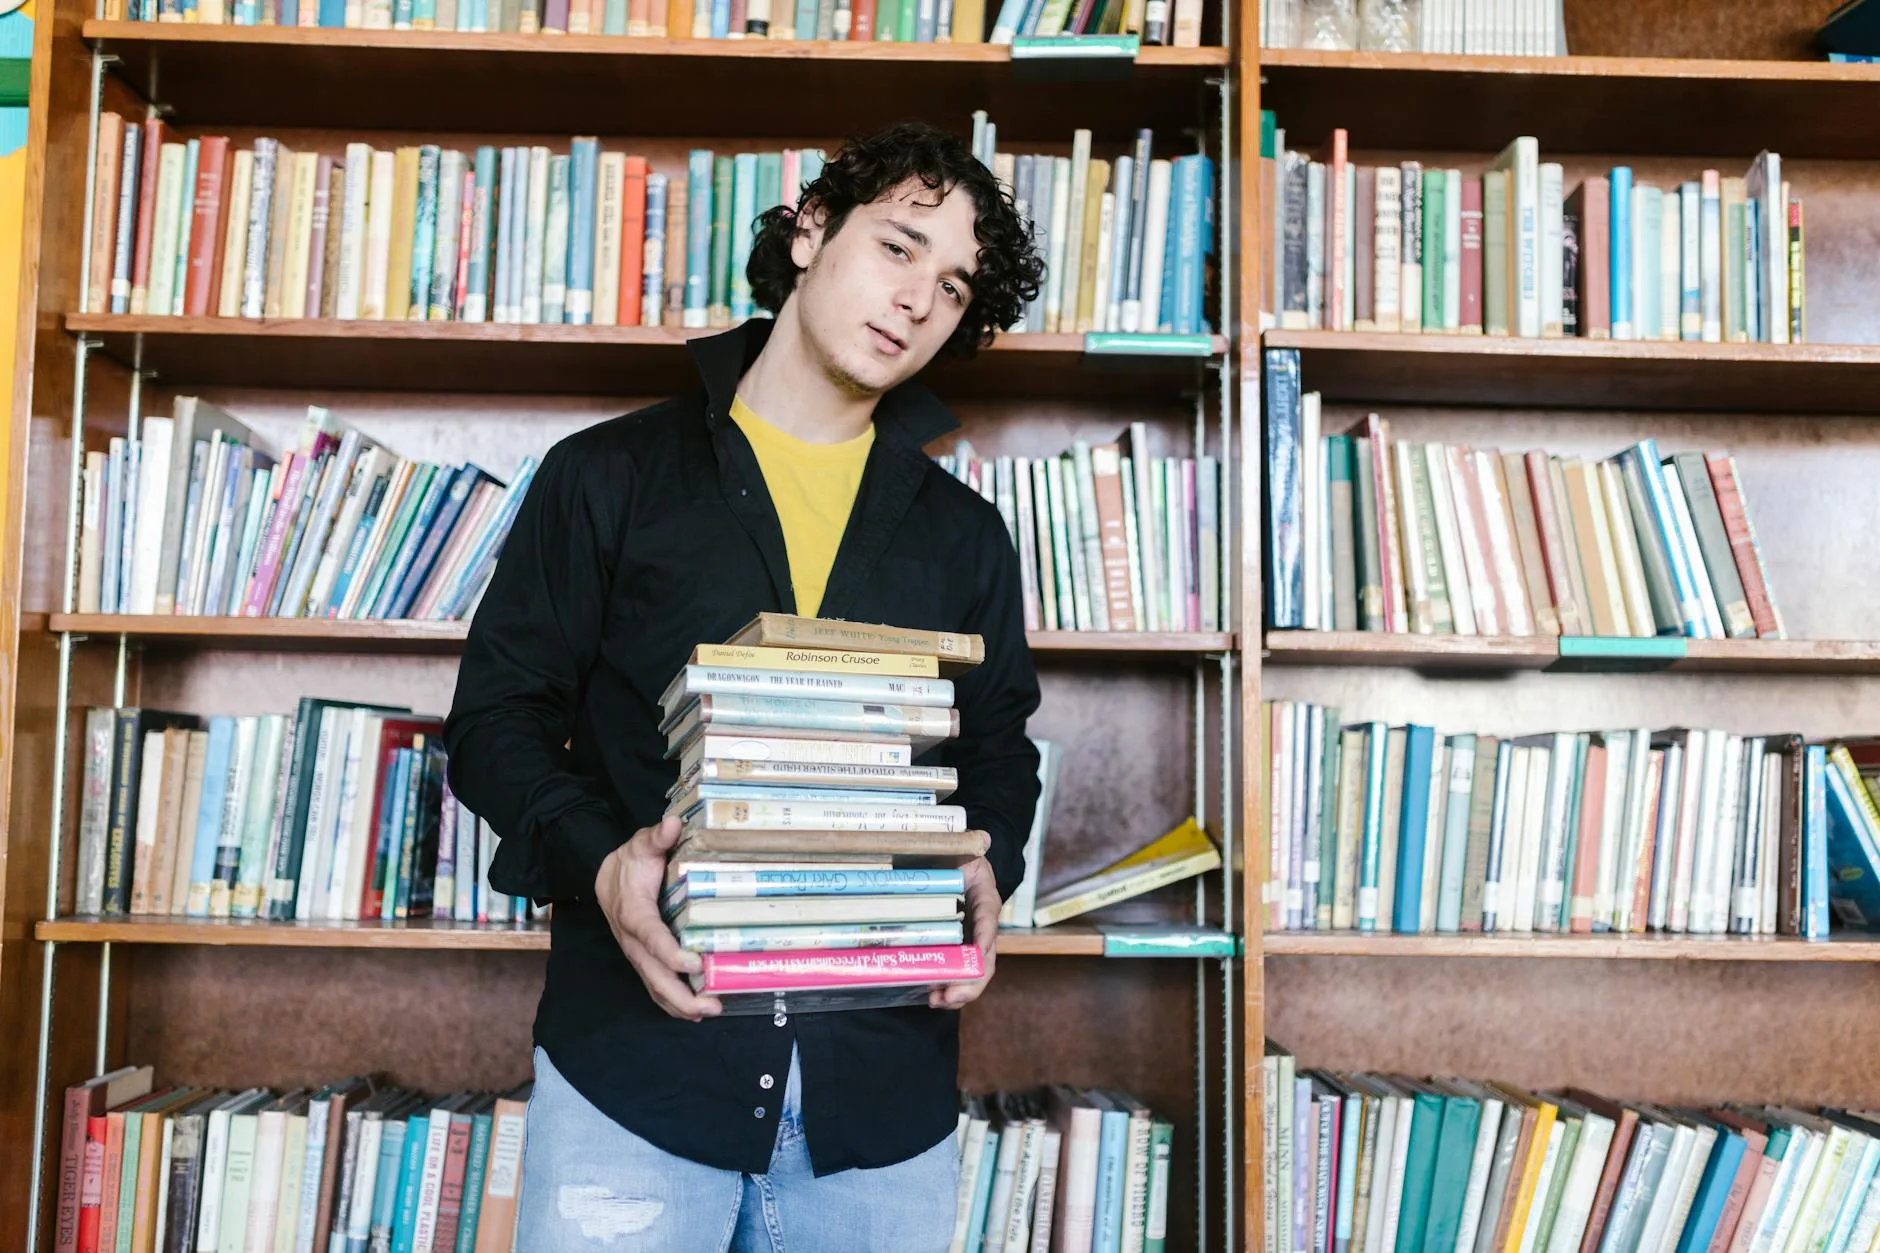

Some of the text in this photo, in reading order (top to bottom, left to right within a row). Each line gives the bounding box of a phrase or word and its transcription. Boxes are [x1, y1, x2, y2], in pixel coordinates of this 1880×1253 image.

[878, 633, 900, 644] Young
[712, 649, 756, 659] Daniel Defoe
[786, 651, 880, 666] Robinson Crusoe
[707, 672, 843, 688] DRAGONWAGON THE YEAR IT RAINED
[801, 764, 837, 774] SILVER
[860, 766, 871, 776] OF
[811, 872, 848, 892] GARY
[857, 871, 930, 892] CANYONS
[871, 953, 897, 968] Sally
[897, 951, 946, 965] Starring
[430, 1132, 442, 1151] LIFE
[1278, 1128, 1289, 1170] MINN
[428, 1156, 438, 1169] ON
[64, 1155, 78, 1199] TIGER
[423, 1182, 435, 1206] COOL
[60, 1206, 75, 1245] EYES
[418, 1211, 432, 1250] PLASTIC
